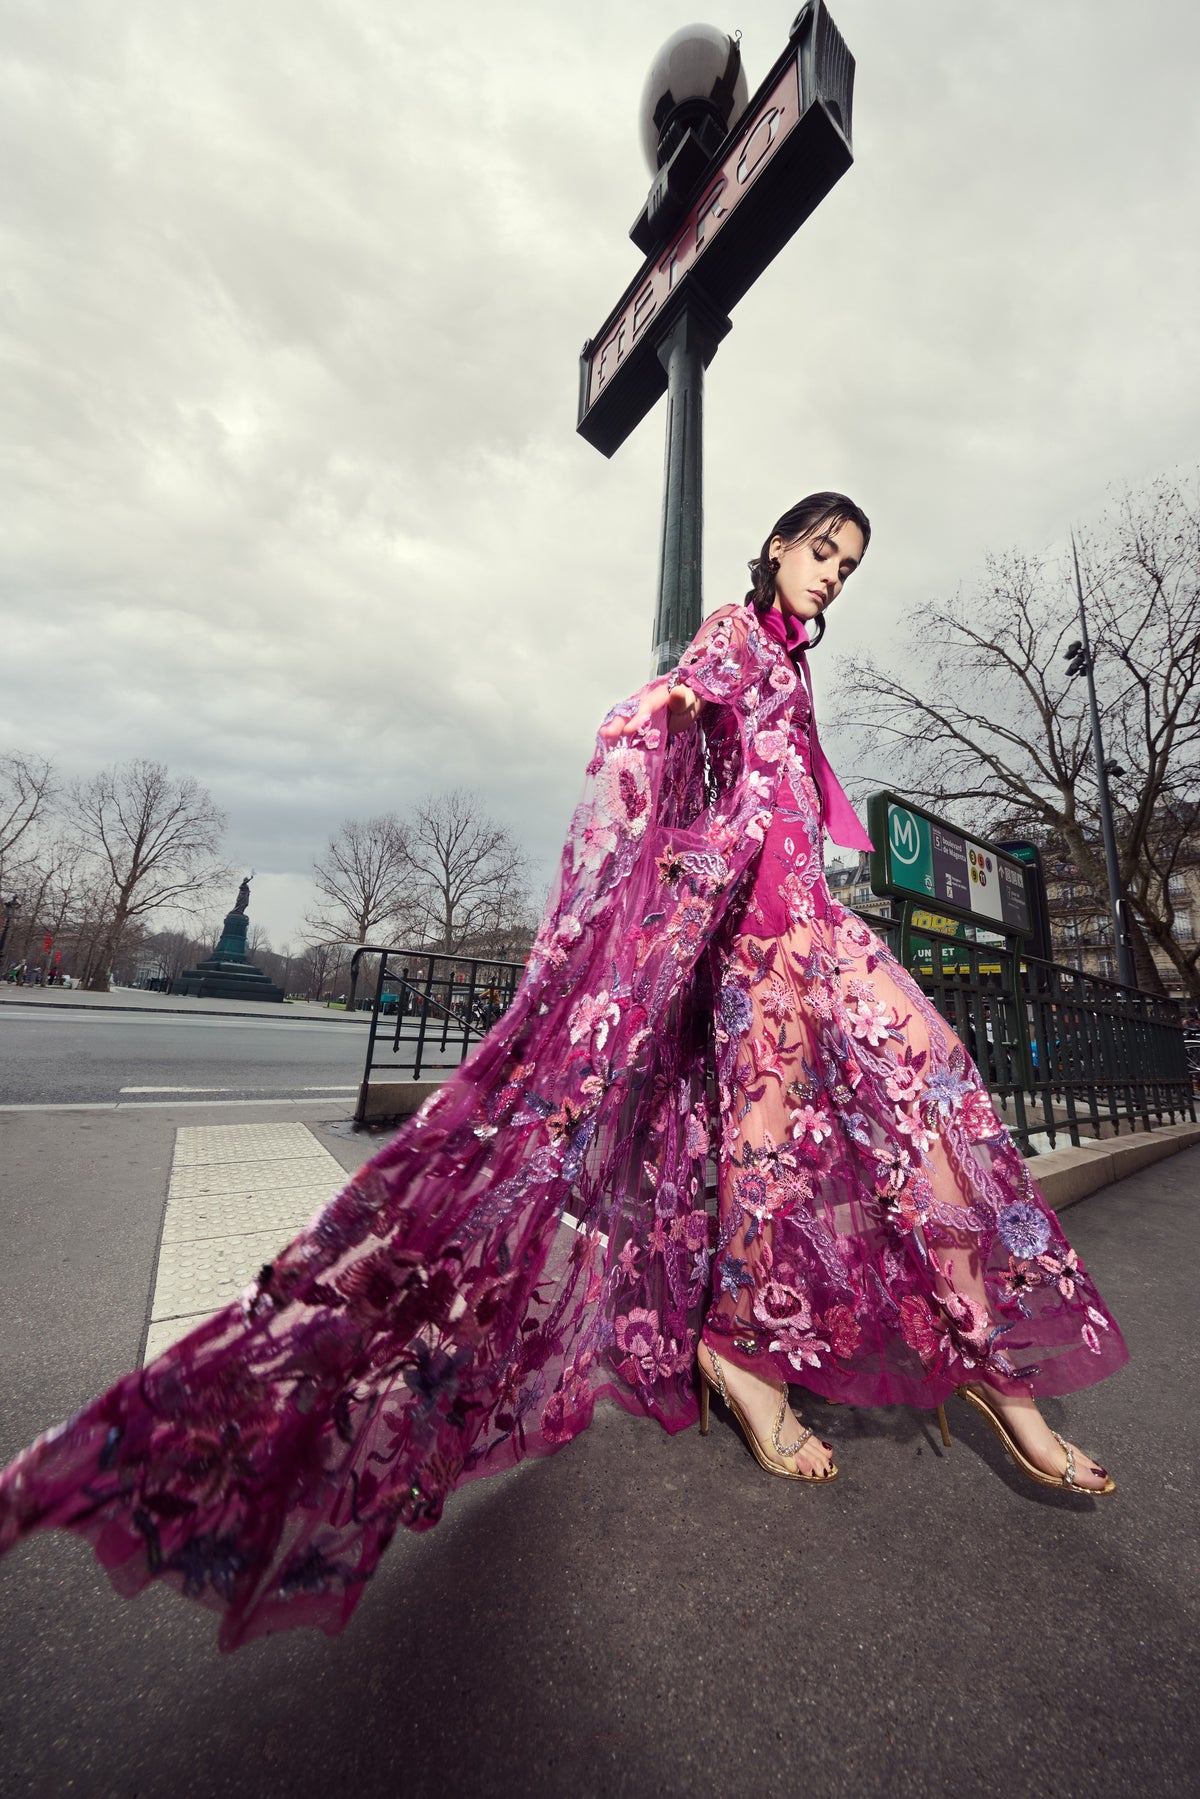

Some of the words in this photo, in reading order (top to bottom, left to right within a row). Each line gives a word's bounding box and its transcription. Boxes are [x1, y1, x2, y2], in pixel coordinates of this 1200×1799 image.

[893, 814, 913, 852] M
[935, 835, 940, 847] 5
[942, 837, 962, 851] boulevard
